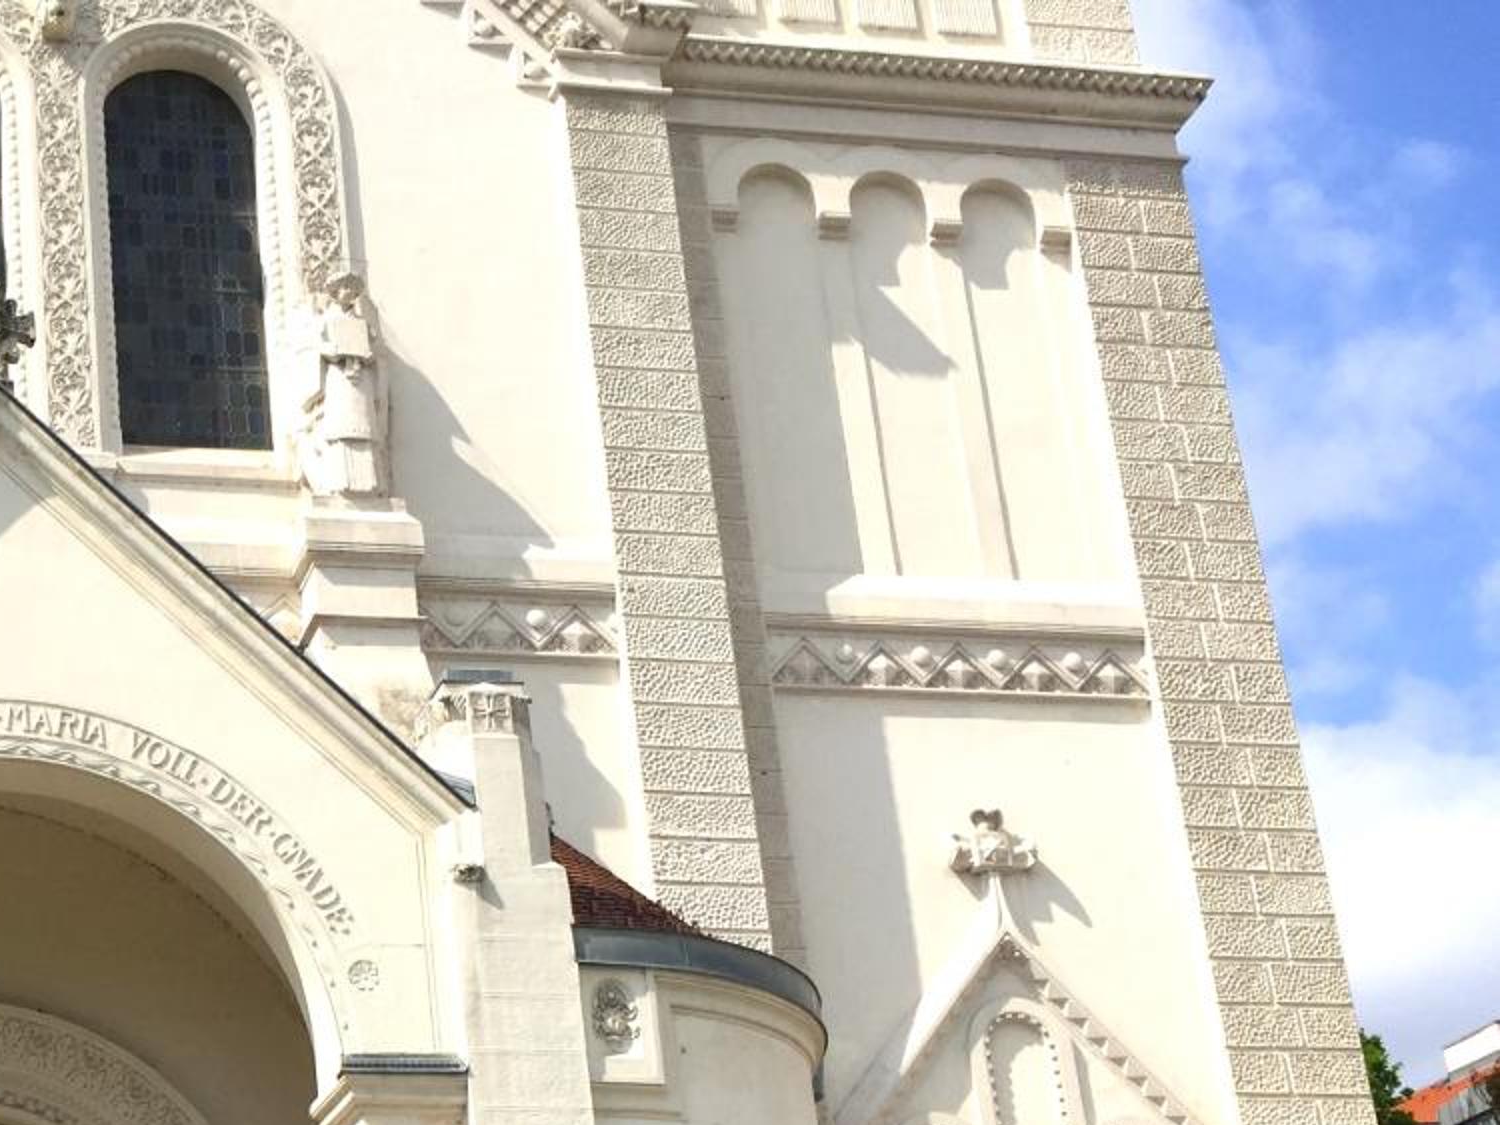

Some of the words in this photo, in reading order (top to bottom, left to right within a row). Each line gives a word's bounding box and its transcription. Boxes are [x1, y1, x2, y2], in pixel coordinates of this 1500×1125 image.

[5, 703, 109, 747] MARIA
[130, 731, 198, 788] VOLL
[209, 778, 272, 836] DER
